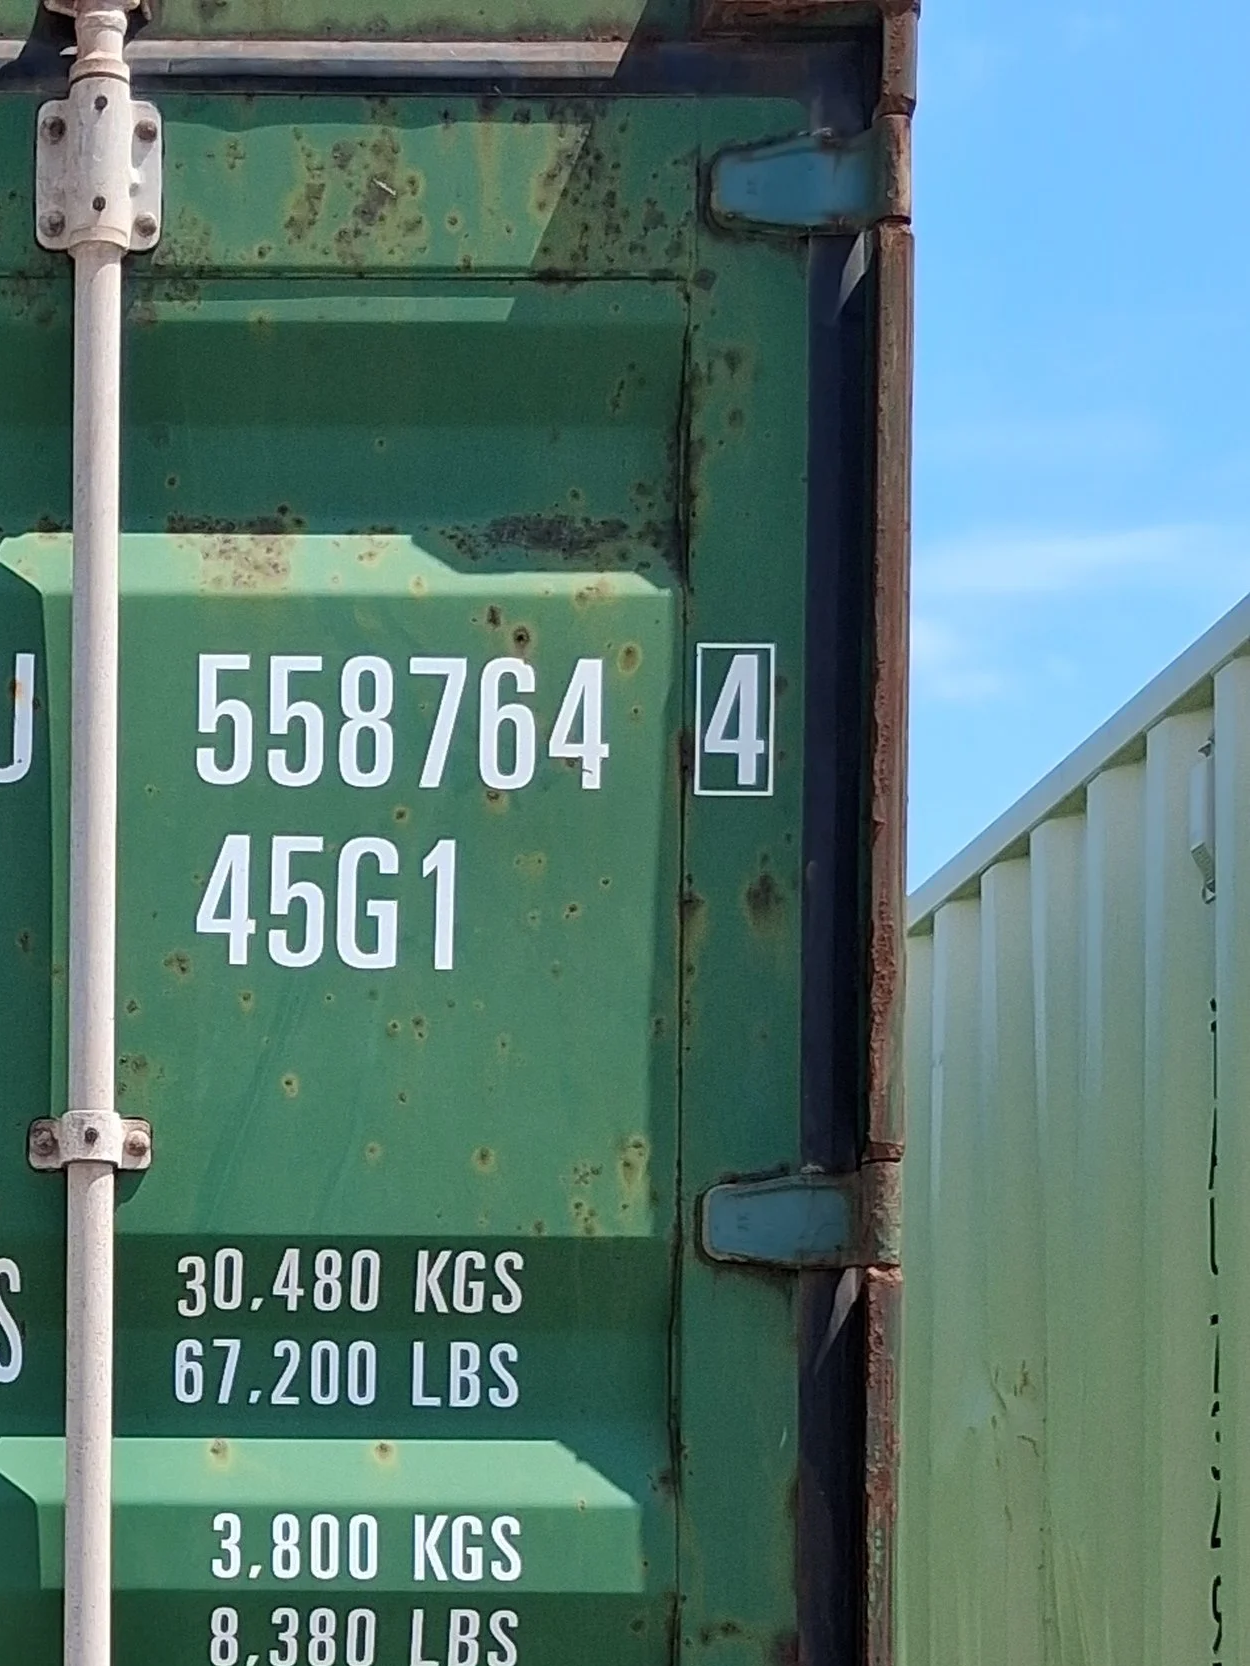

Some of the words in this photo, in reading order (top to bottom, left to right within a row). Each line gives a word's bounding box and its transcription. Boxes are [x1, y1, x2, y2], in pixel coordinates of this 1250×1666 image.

[196, 653, 610, 790] 558764
[704, 654, 765, 785] 4
[196, 834, 456, 970] 45G1
[414, 1249, 524, 1314] KGS
[412, 1341, 520, 1408] LBS
[413, 1514, 523, 1582] KGS
